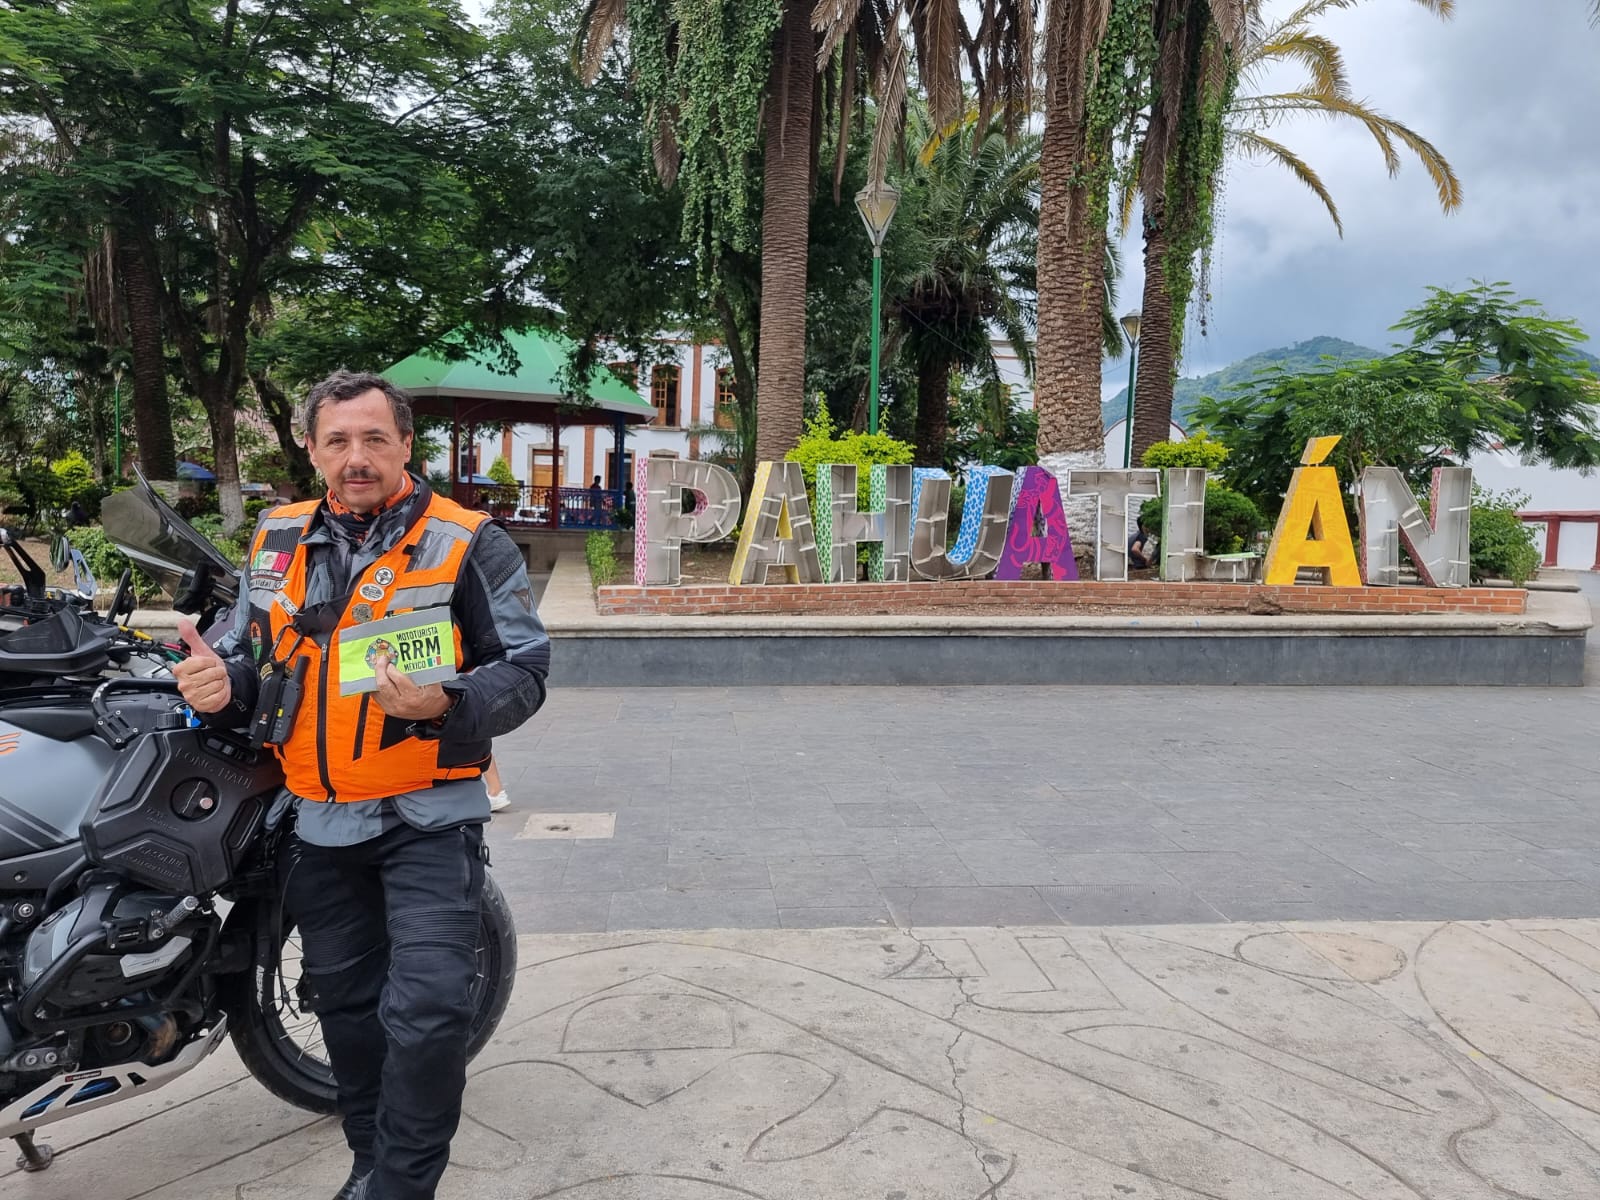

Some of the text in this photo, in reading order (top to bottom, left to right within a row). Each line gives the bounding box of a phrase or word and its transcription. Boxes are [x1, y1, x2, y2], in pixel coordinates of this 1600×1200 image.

[634, 435, 1472, 588] PAHUATLÁN
[396, 627, 438, 641] MOTOTURISTA
[399, 636, 440, 662] RRM
